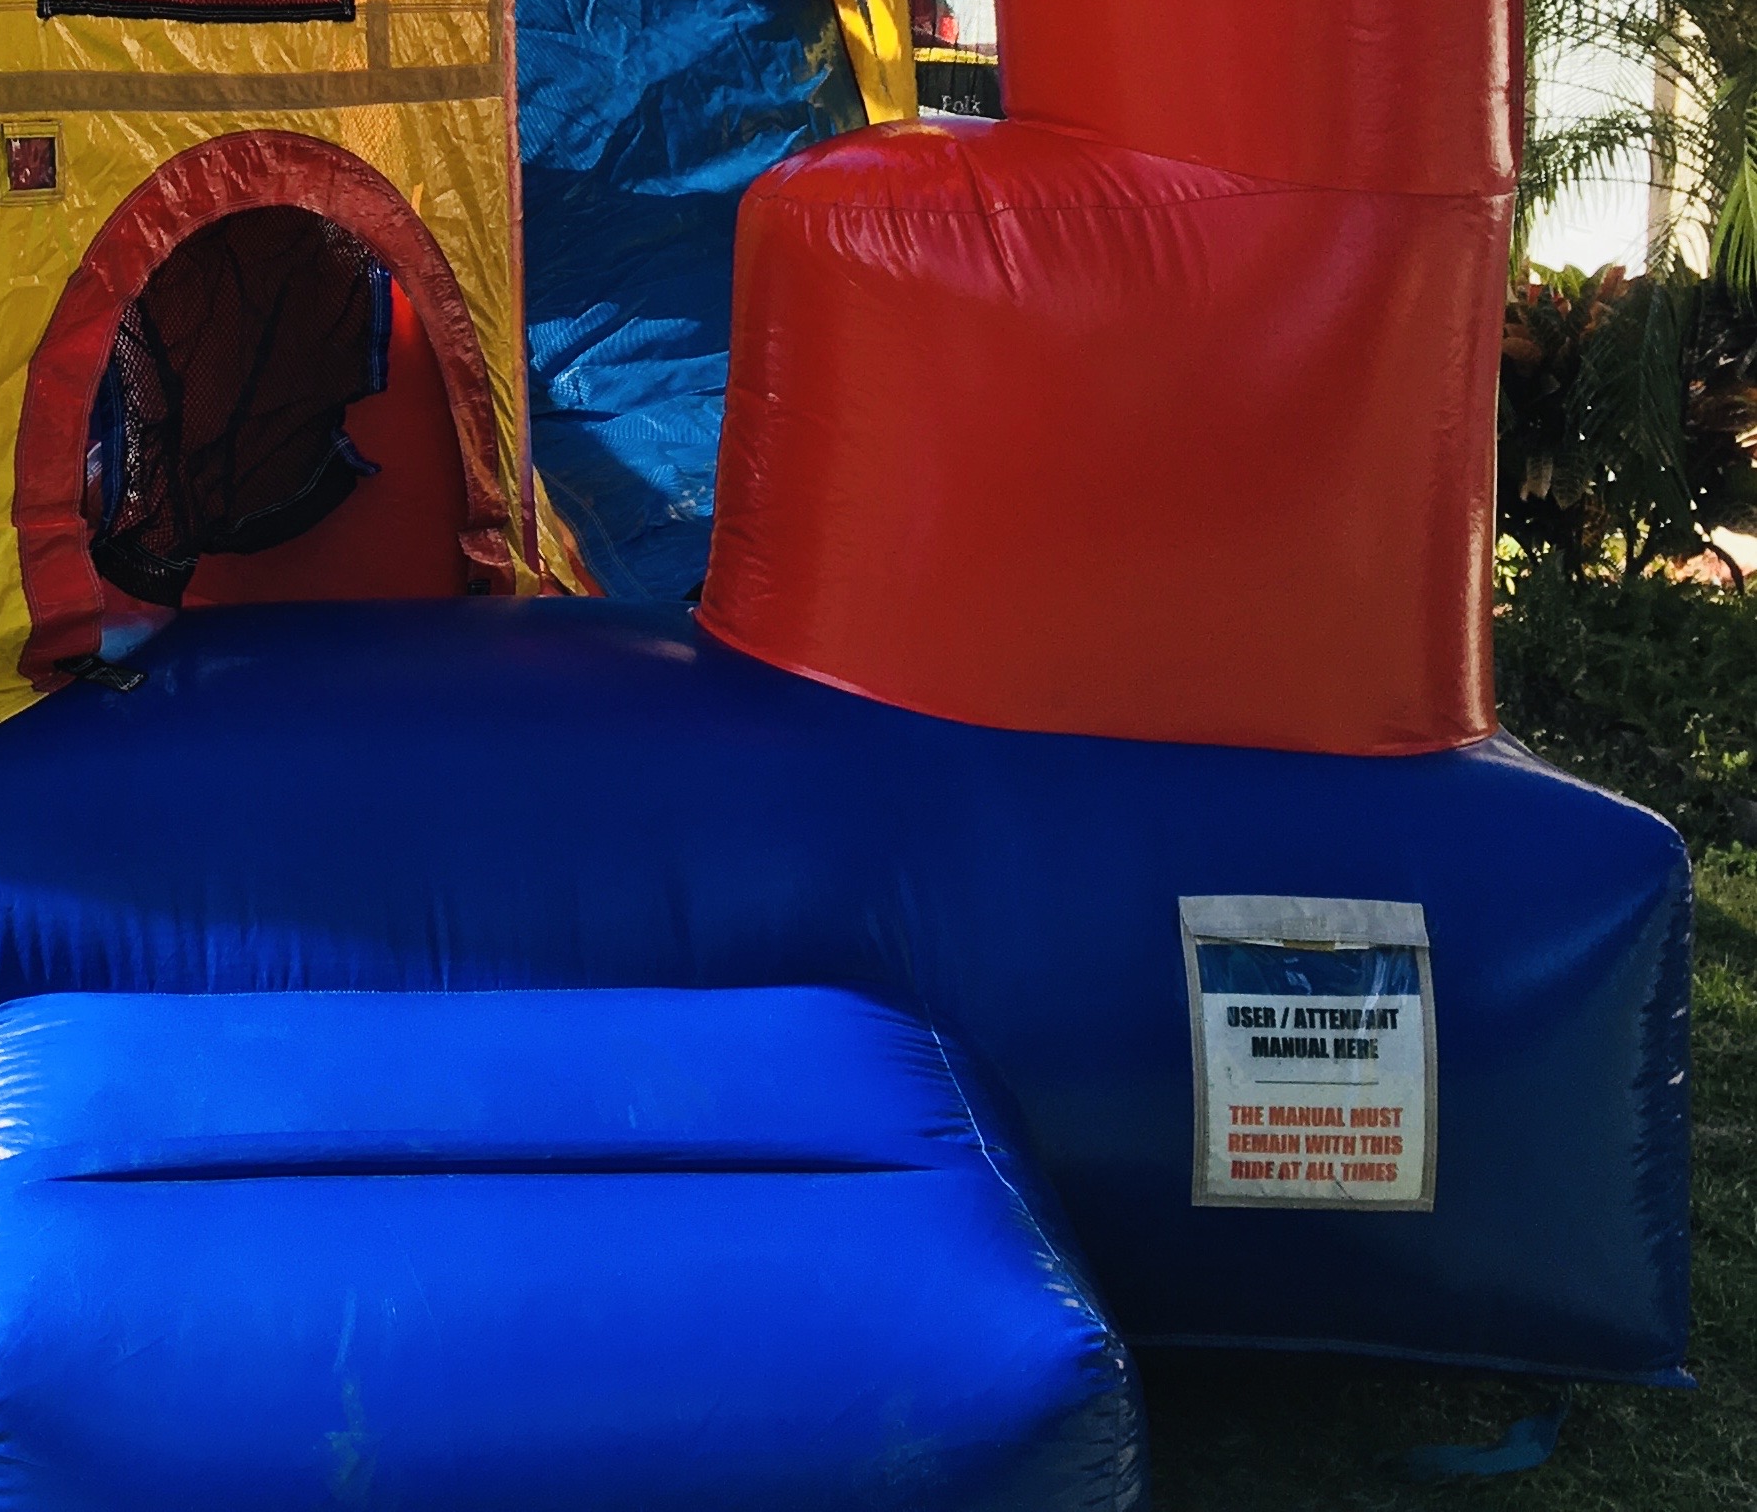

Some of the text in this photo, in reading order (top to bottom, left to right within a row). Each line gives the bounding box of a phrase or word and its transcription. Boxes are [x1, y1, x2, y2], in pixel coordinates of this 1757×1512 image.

[1226, 1006, 1400, 1030] USER / ATTENDANT
[1251, 1036, 1380, 1060] MANUAL HERE
[1228, 1104, 1404, 1128] THE MANUAL MUST
[1227, 1132, 1404, 1156] REMAIN WITH THIS
[1230, 1160, 1398, 1182] RIDE AT ALL TIMES
